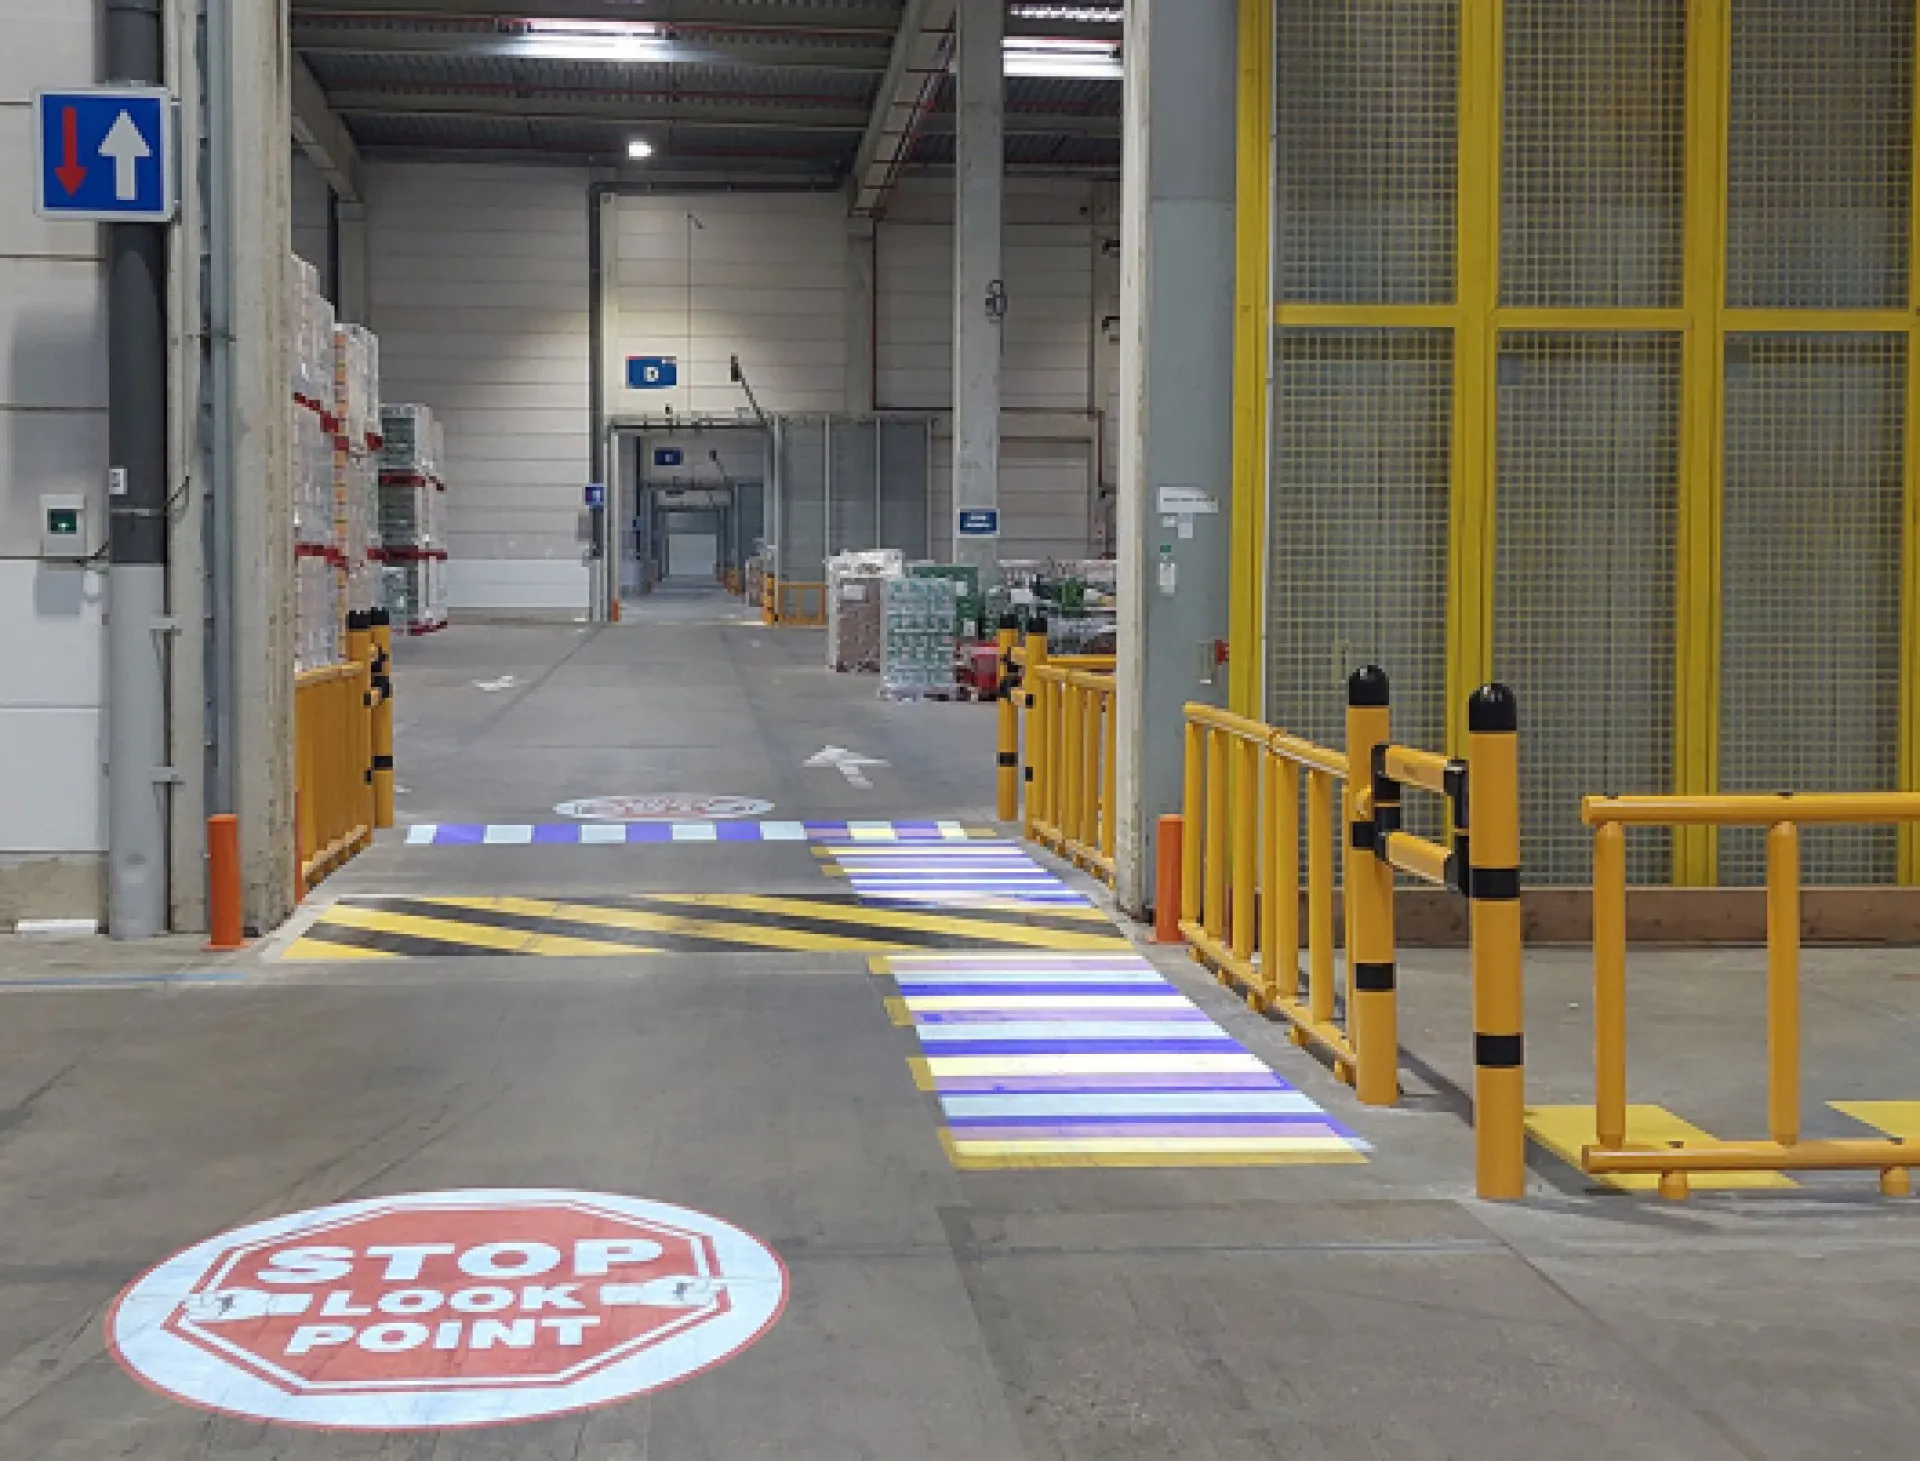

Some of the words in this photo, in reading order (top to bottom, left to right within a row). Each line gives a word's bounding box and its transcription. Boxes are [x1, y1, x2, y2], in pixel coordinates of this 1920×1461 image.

[257, 1239, 663, 1284] STOP
[320, 1285, 585, 1316] LOOK
[284, 1316, 601, 1356] POINT
